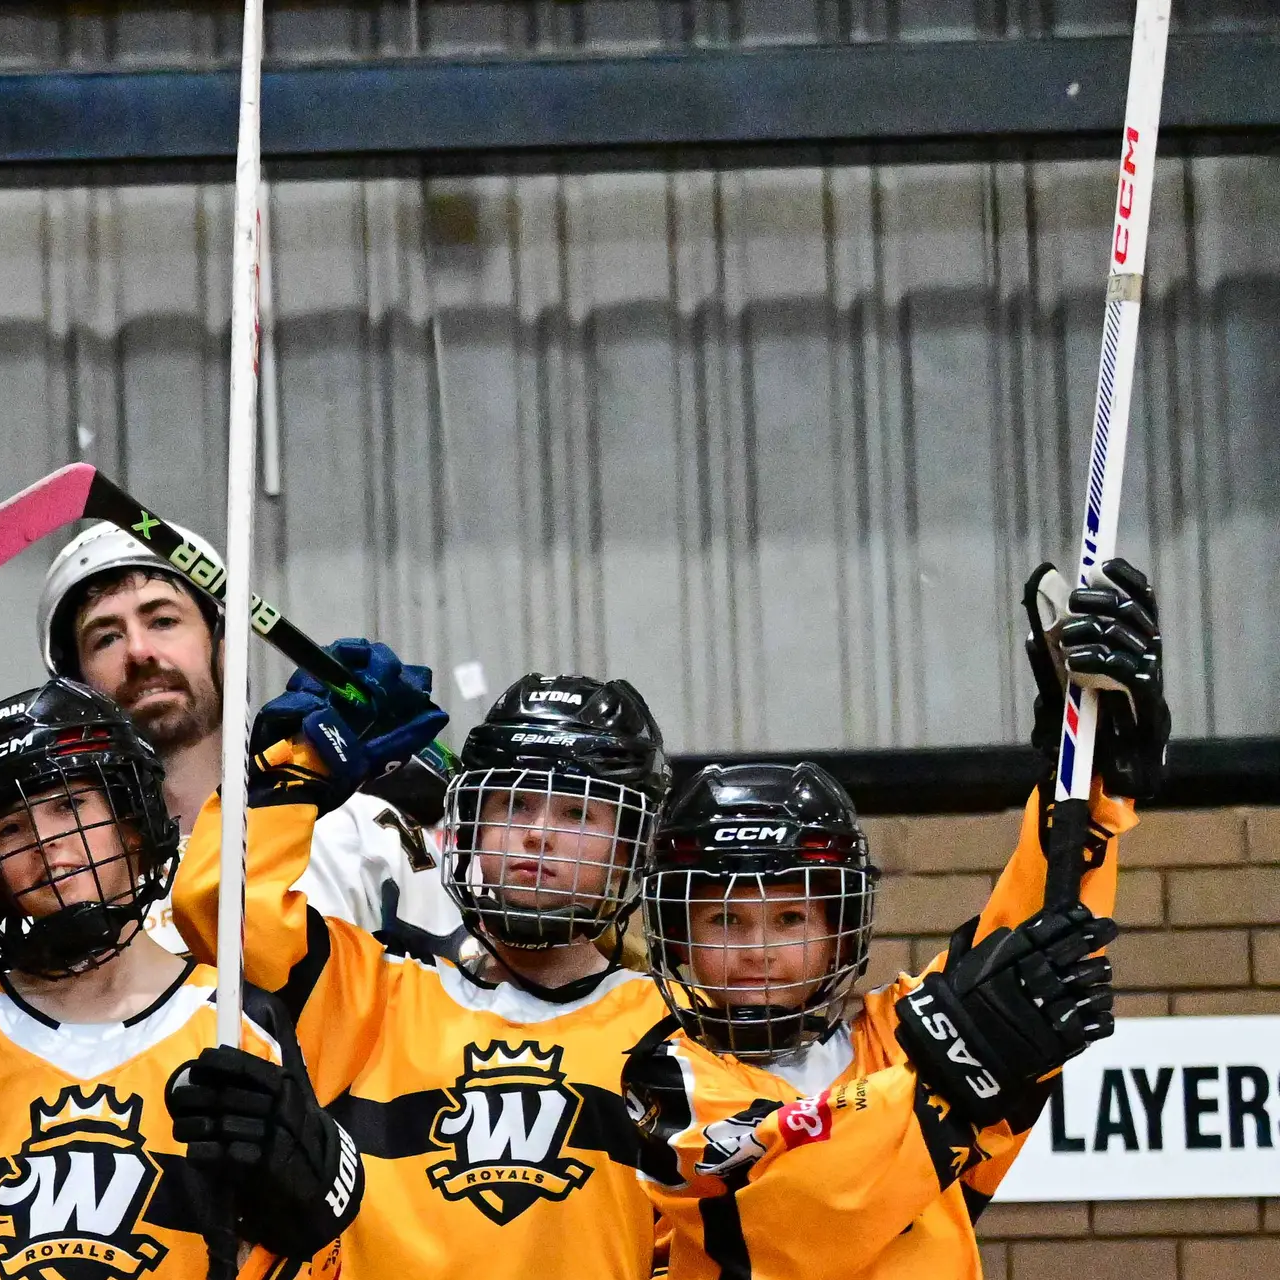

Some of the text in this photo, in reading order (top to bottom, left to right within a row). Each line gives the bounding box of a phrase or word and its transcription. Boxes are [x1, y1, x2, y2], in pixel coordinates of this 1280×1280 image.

[1112, 126, 1139, 265] CCM
[527, 690, 583, 706] LYDIA
[510, 732, 578, 748] BAUER
[714, 826, 788, 842] CCM
[1050, 1066, 1280, 1152] LAYER
[440, 1089, 567, 1164] W
[465, 1169, 545, 1185] ROYALS
[25, 1243, 116, 1262] ROYALS
